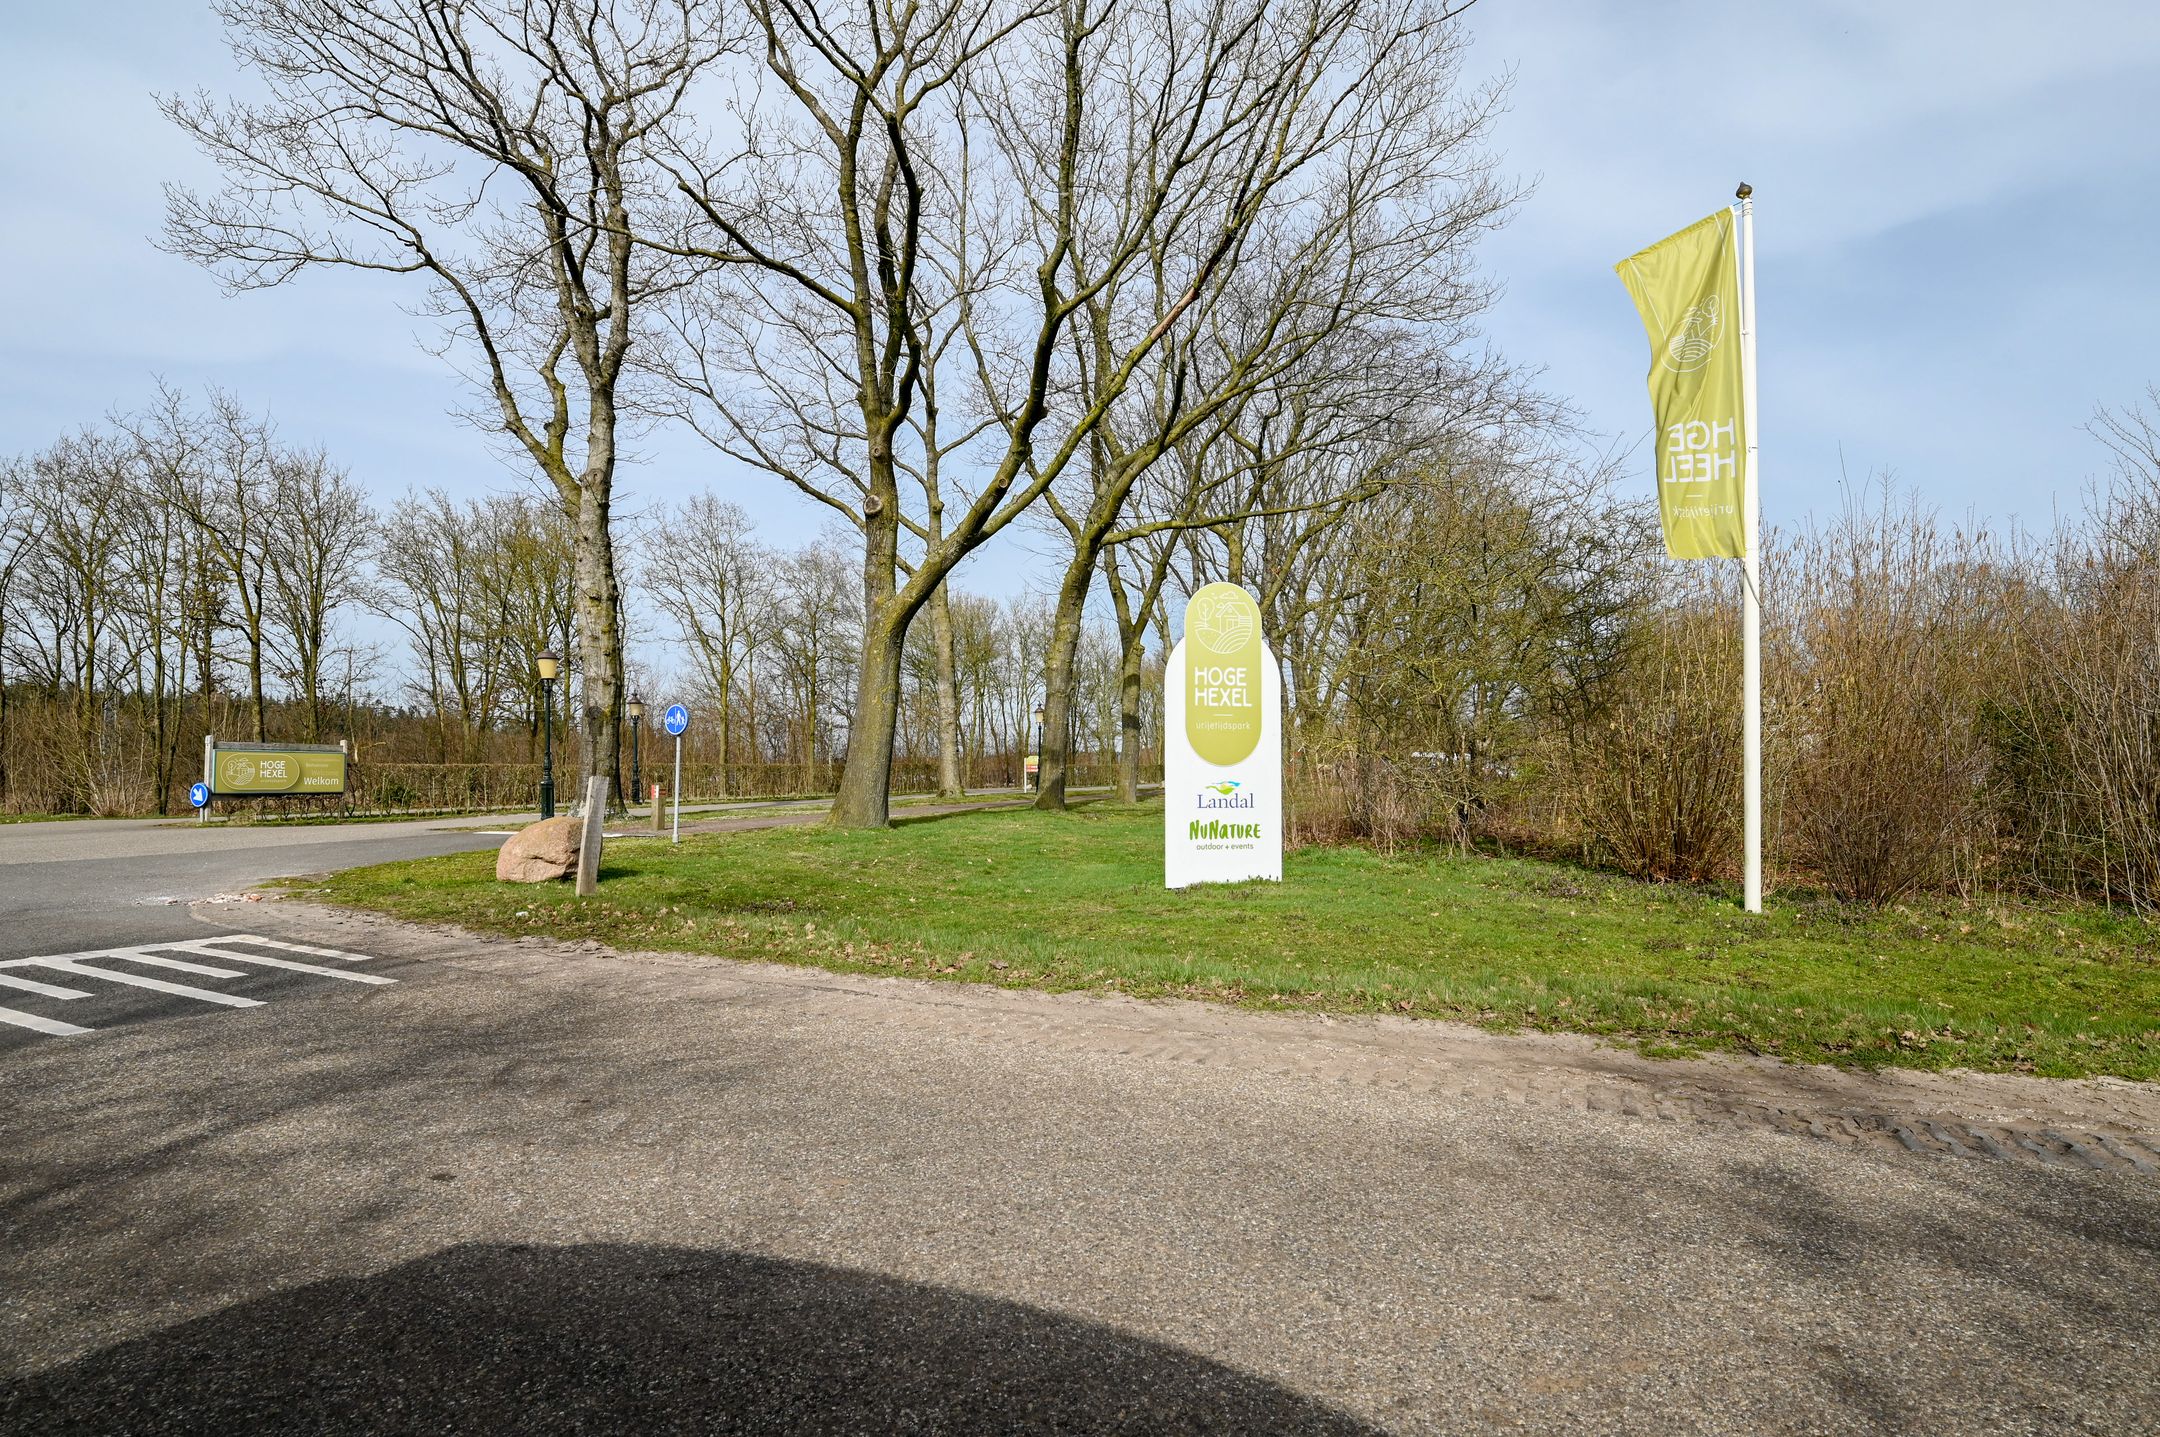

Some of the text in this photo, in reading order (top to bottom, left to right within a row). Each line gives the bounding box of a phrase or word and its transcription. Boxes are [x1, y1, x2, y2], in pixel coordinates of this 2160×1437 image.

[1194, 666, 1248, 686] HOGE
[1194, 687, 1253, 707] HEXEL
[260, 760, 286, 770] HOGE
[259, 769, 288, 779] HEXEL
[304, 776, 340, 785] Welkom
[1197, 792, 1255, 809] Landal
